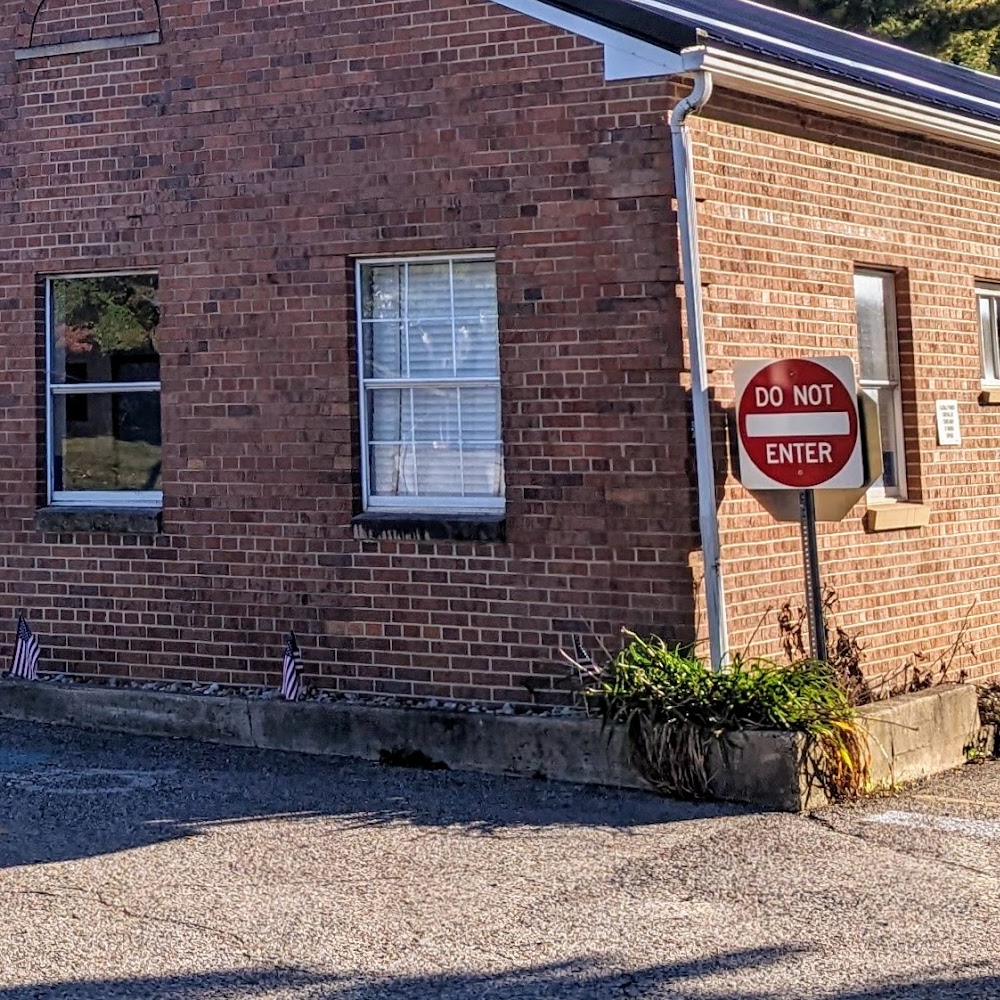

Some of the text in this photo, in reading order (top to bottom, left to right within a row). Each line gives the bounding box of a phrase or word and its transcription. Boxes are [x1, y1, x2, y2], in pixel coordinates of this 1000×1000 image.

[755, 384, 834, 407] DO NOT
[766, 442, 833, 464] ENTER
